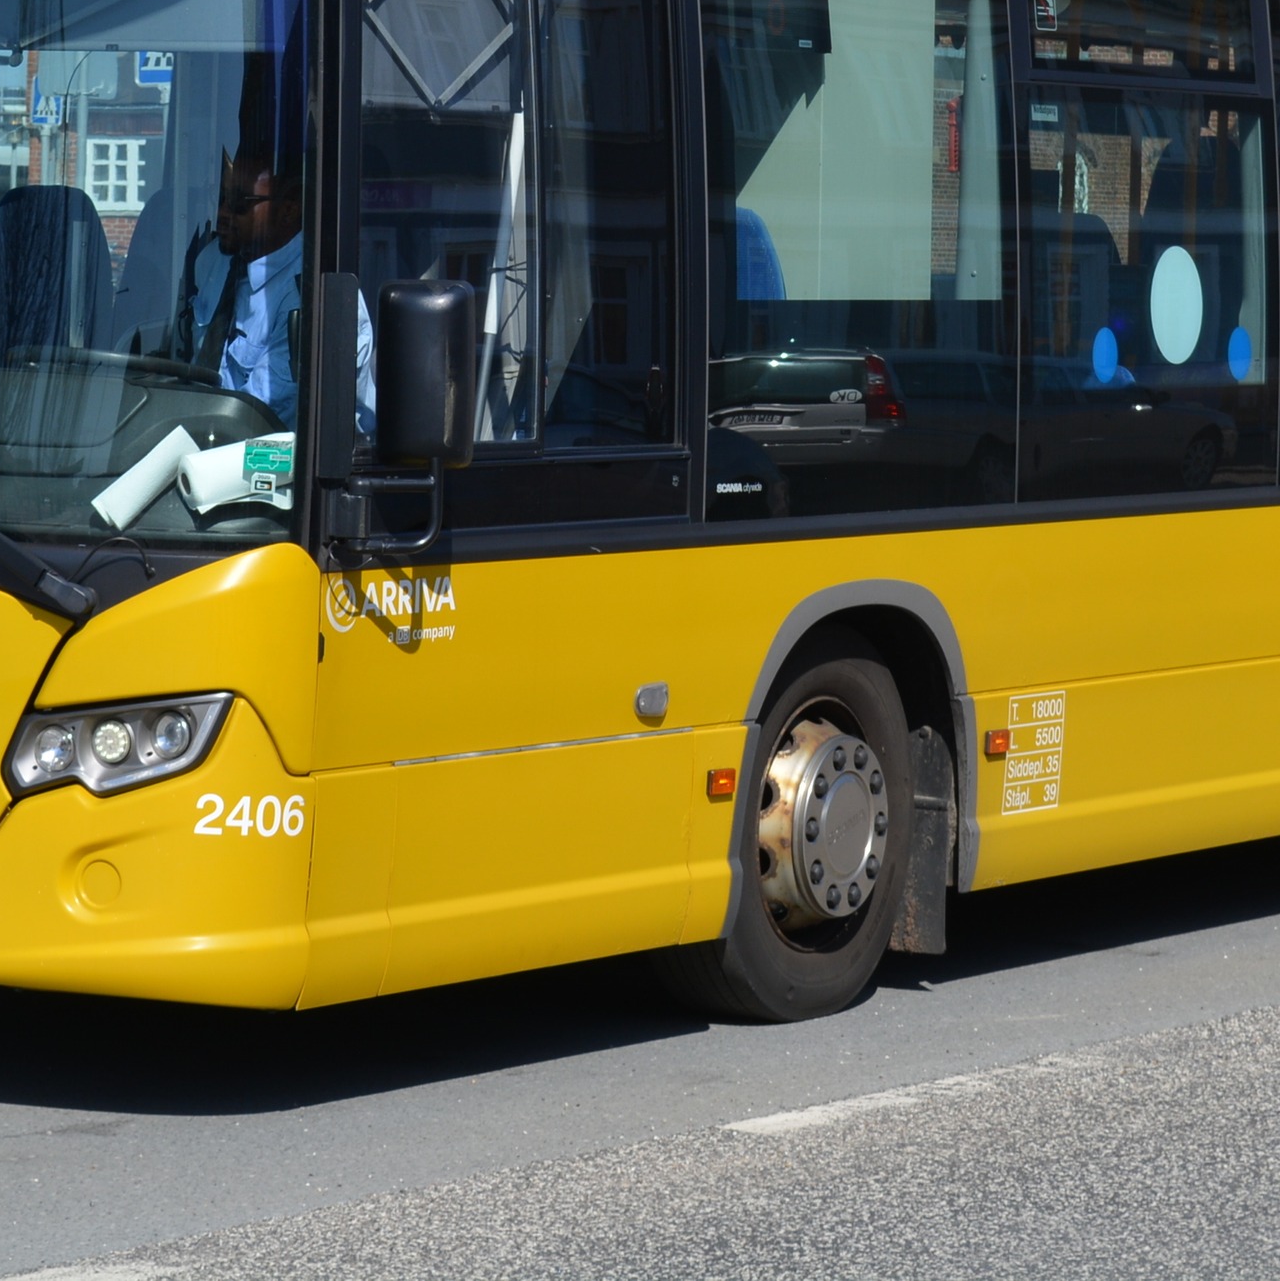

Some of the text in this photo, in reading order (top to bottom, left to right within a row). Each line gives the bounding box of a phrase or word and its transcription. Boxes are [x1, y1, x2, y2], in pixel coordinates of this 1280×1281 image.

[716, 482, 743, 494] SCANIA
[360, 575, 456, 618] ARRIVA
[412, 625, 456, 643] company
[1031, 697, 1063, 719] 18000
[1035, 725, 1061, 747] 5500
[1007, 754, 1059, 780] Siddepl. 35
[1005, 782, 1057, 810] Ståpl. 39
[193, 792, 306, 838] 2406
